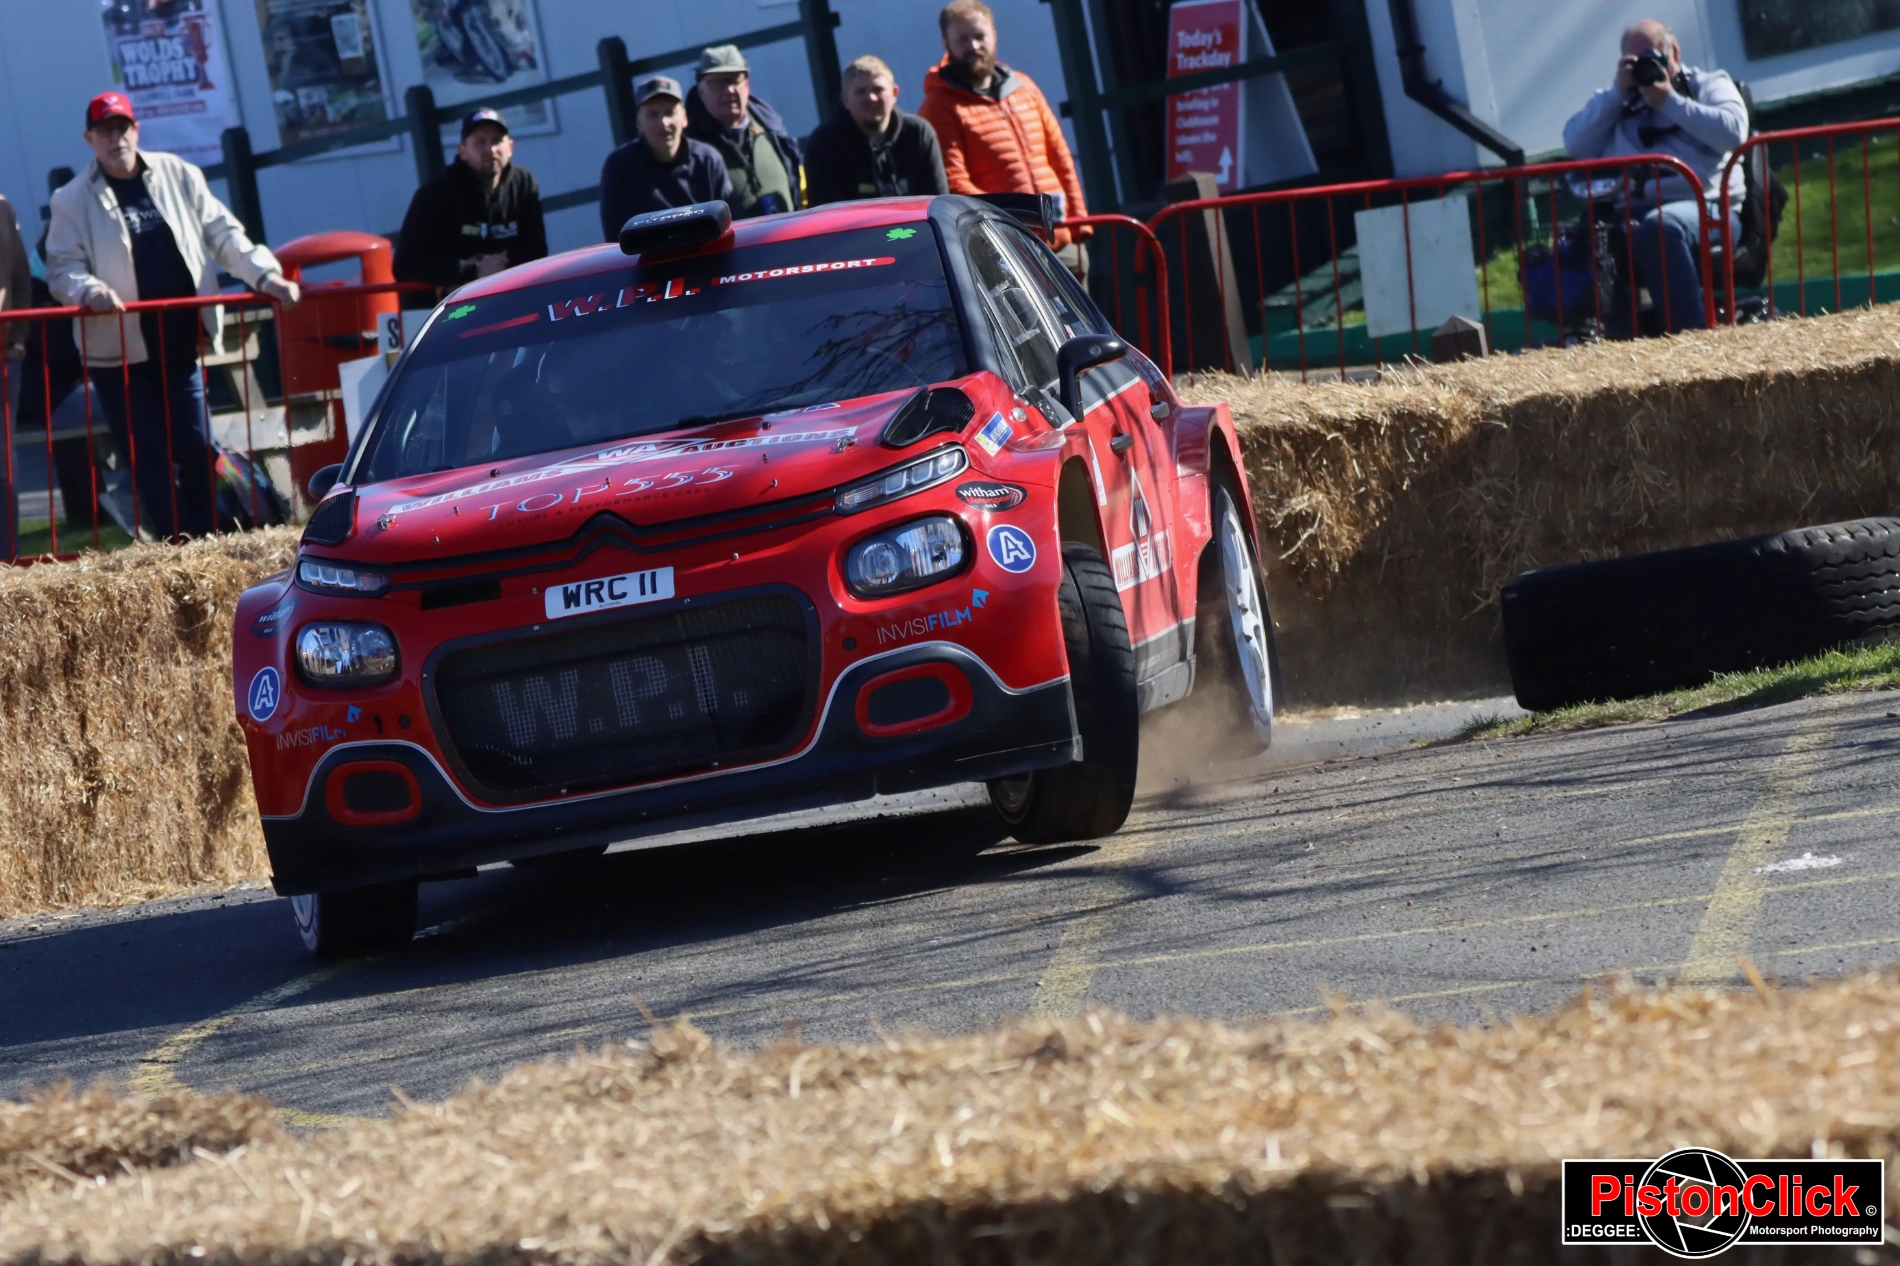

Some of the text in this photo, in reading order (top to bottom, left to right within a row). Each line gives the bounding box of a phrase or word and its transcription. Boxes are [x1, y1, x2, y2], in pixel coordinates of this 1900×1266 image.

[120, 36, 184, 64] WOLDS
[1176, 29, 1223, 49] Today's
[124, 57, 198, 87] TROPHY
[1175, 50, 1232, 71] Trackday
[718, 257, 877, 285] MOTORSPORT
[598, 443, 657, 460] WA
[677, 427, 852, 454] AUCTIONS
[402, 468, 563, 512] WILLIAMS
[674, 486, 710, 497] CARS
[562, 575, 629, 610] WRC
[876, 606, 973, 645] INVISIFILM
